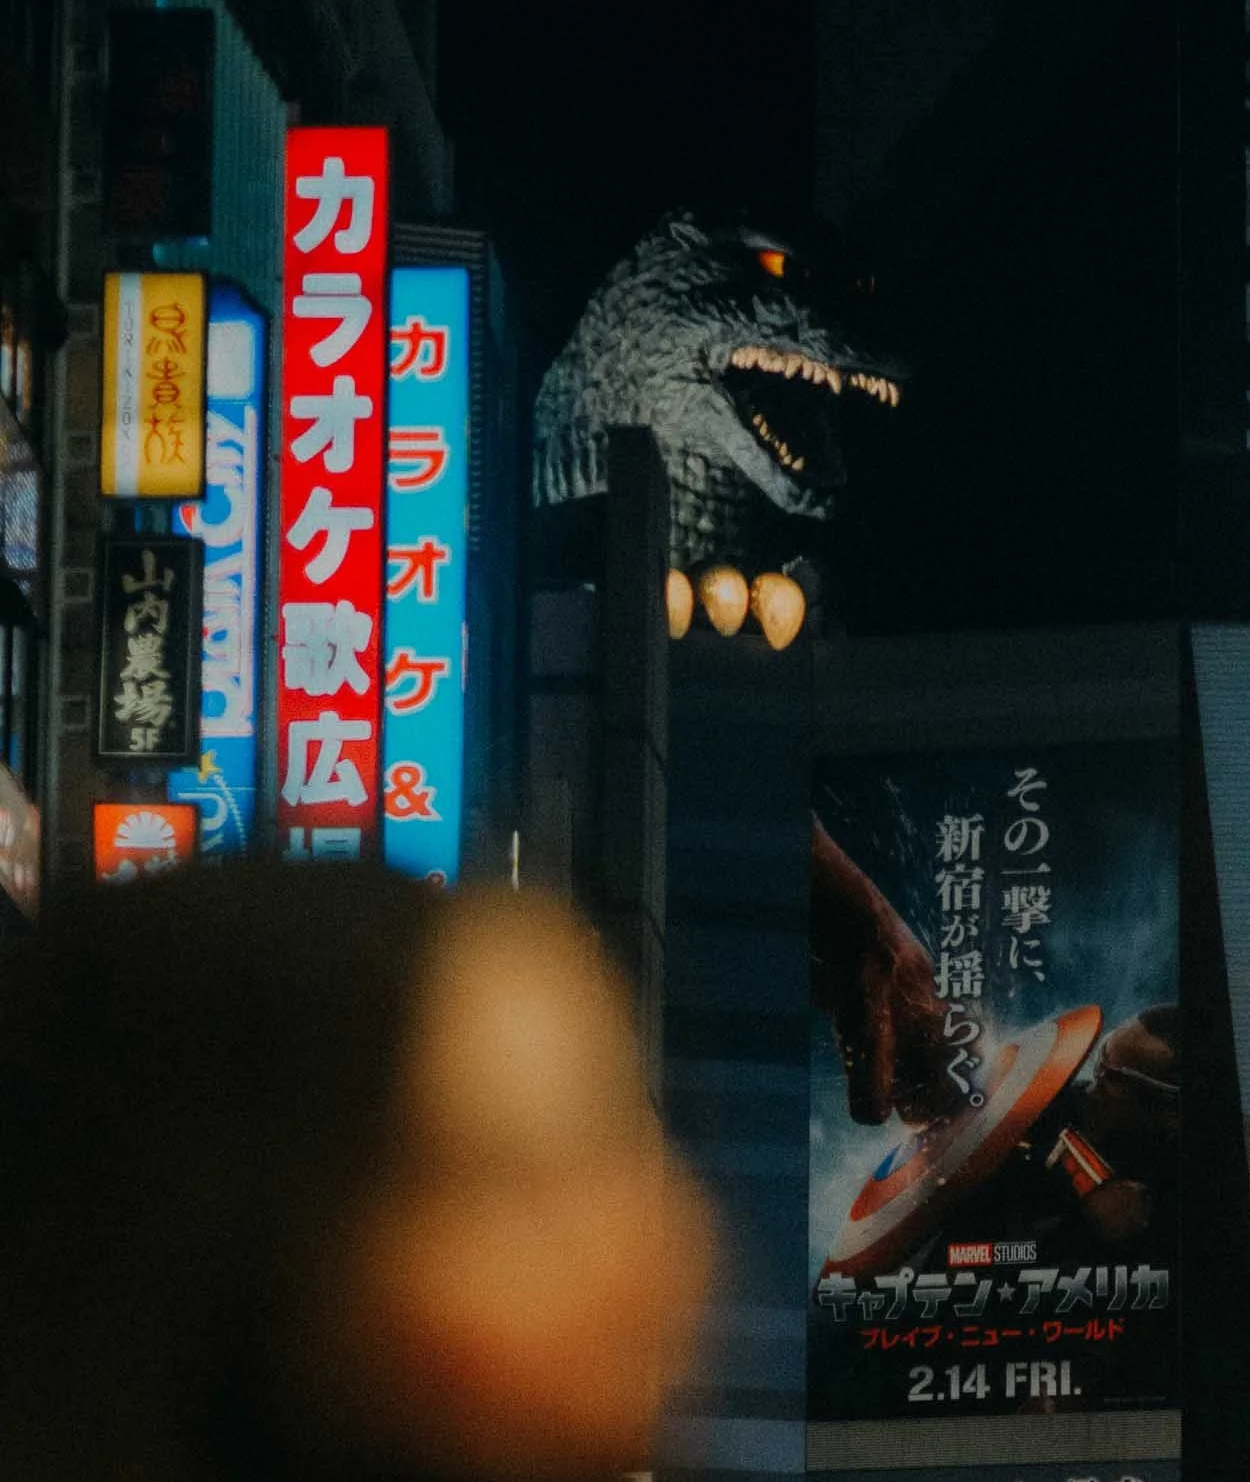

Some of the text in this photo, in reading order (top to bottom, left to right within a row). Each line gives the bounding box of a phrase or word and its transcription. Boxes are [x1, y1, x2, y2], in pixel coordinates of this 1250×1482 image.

[114, 549, 175, 727] 山内農場
[384, 316, 450, 885] カラオケ&
[130, 729, 161, 751] 5F
[1000, 767, 1052, 983] その一撃に、
[933, 813, 986, 1109] 新宿が揺らぐ。
[949, 1243, 1037, 1265] MARVEL STUDIOS
[859, 1320, 1125, 1351] ブレイブ・ニュー・ワールド
[907, 1360, 1083, 1403] 2.14 FRI.
